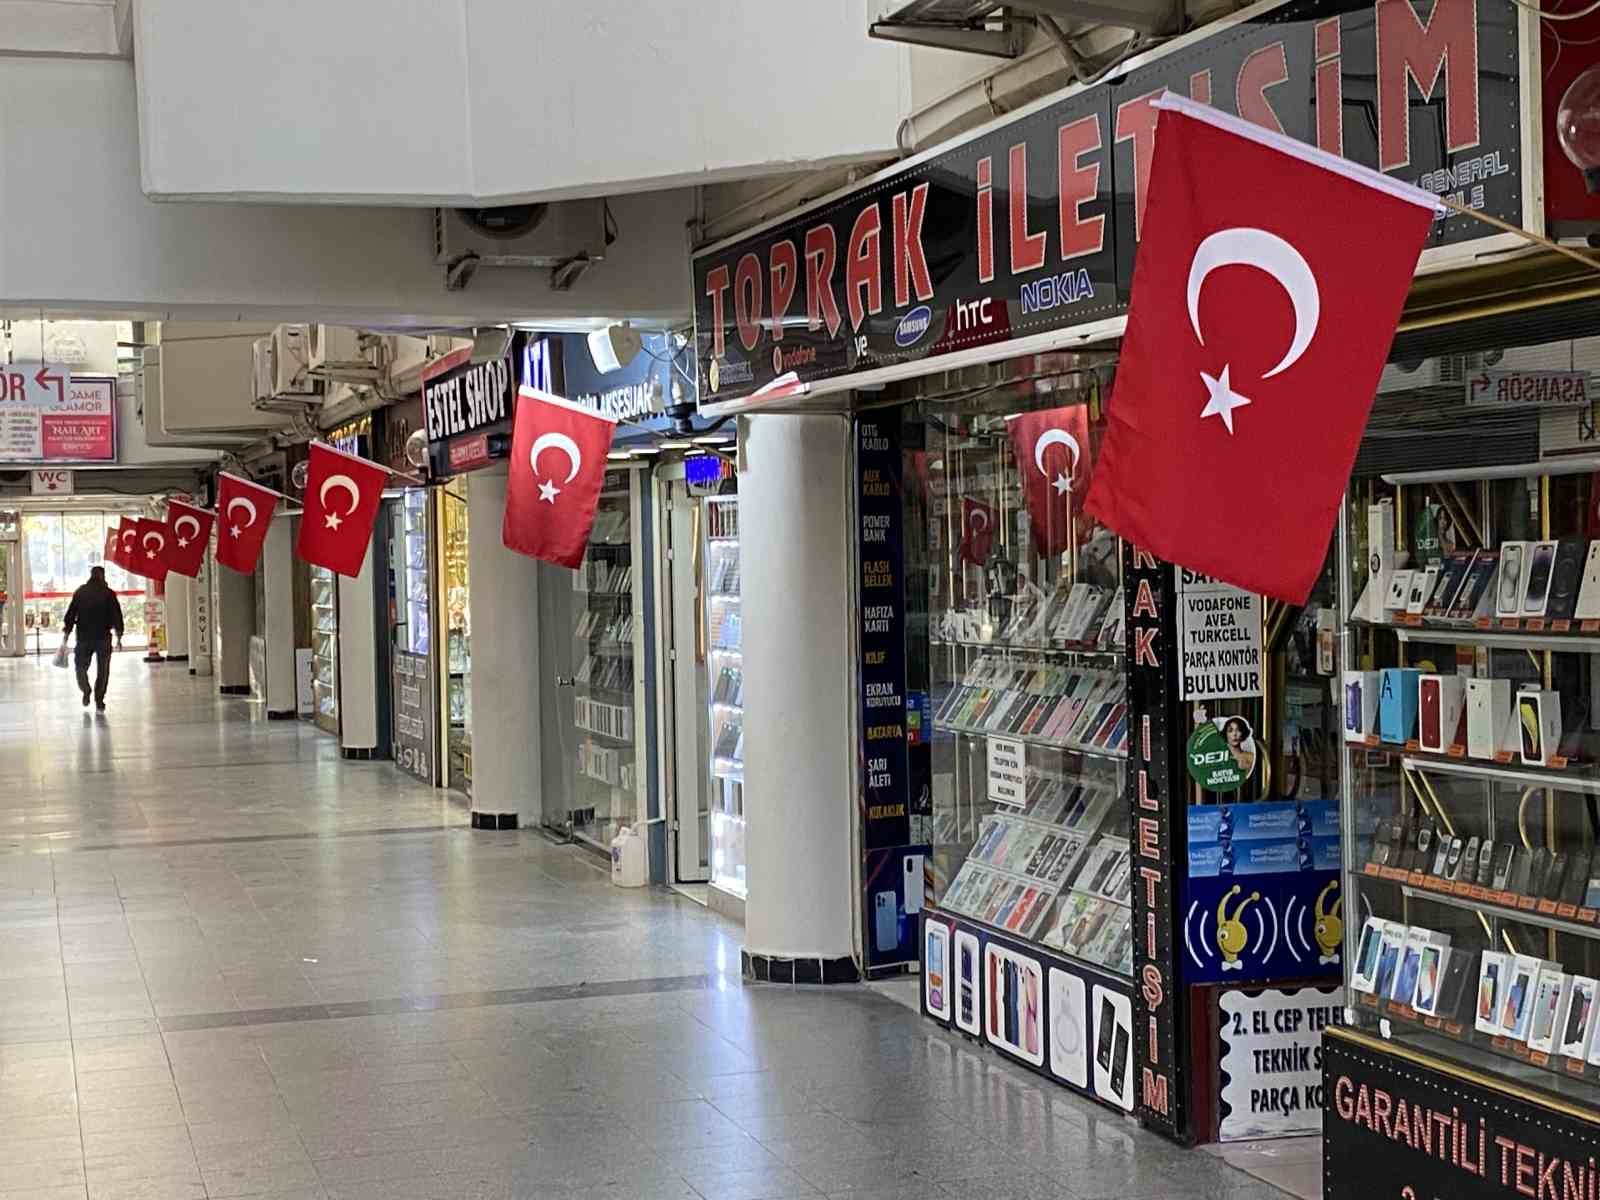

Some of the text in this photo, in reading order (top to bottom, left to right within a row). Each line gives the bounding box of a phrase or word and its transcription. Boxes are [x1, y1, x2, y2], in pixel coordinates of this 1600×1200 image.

[1421, 150, 1509, 193] GENERAL
[706, 182, 934, 358] TOPRAK
[1020, 268, 1096, 314] NOKIA
[899, 316, 928, 336] SAMSUNG
[854, 333, 868, 358] ve
[426, 376, 467, 440] ESTEL
[466, 357, 508, 431] SHOP
[38, 471, 67, 482] WC
[863, 516, 890, 528] POWER
[863, 529, 886, 542] BANK
[864, 606, 894, 619] HAFIZA
[1188, 597, 1251, 612] VODAFONE
[1204, 612, 1236, 627] AVEA
[1190, 627, 1251, 644] TURKCELL
[1184, 651, 1216, 672] PARÇA
[866, 683, 894, 696] EKRAN
[1185, 672, 1260, 694] BULUNUR
[1232, 1011, 1248, 1036] 2.
[1253, 1009, 1271, 1034] EL
[1274, 1007, 1302, 1033] CEP
[1252, 1044, 1309, 1074] TEKNİK
[1250, 1087, 1301, 1118] PARÇA
[1335, 1075, 1486, 1177] GARANTİLİ
